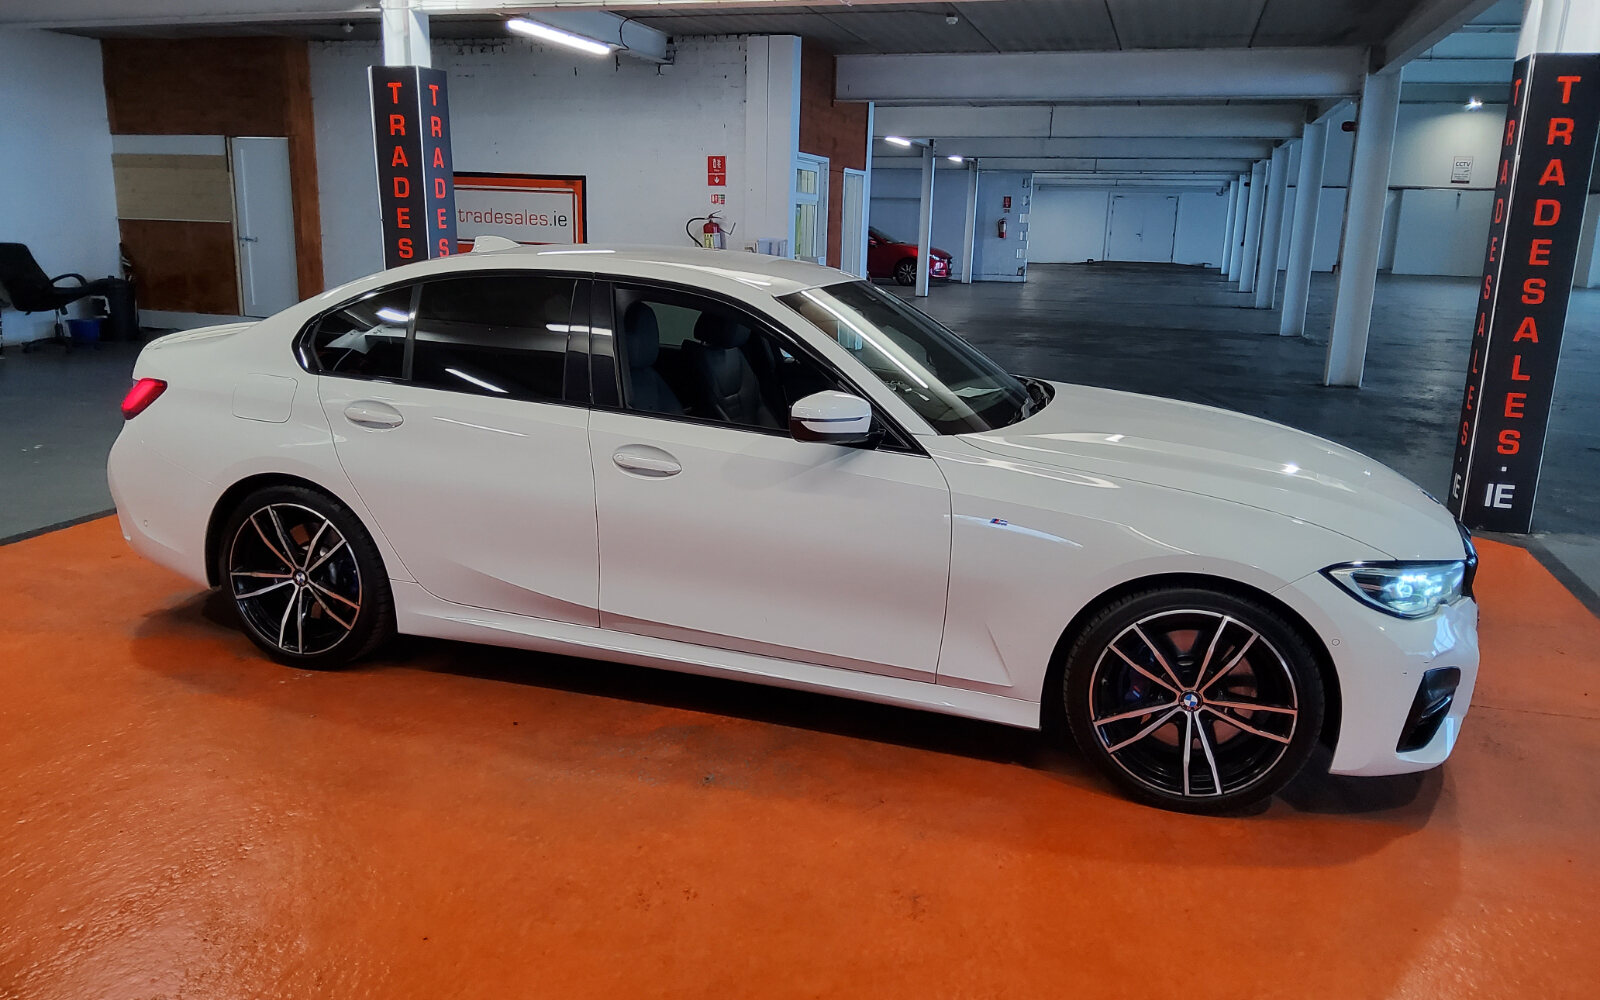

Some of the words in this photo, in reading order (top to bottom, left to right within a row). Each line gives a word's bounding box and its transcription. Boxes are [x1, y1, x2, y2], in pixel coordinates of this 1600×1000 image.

[387, 82, 414, 259] TRADES
[428, 84, 449, 257] TRADES
[458, 208, 567, 227] tradesales.ie
